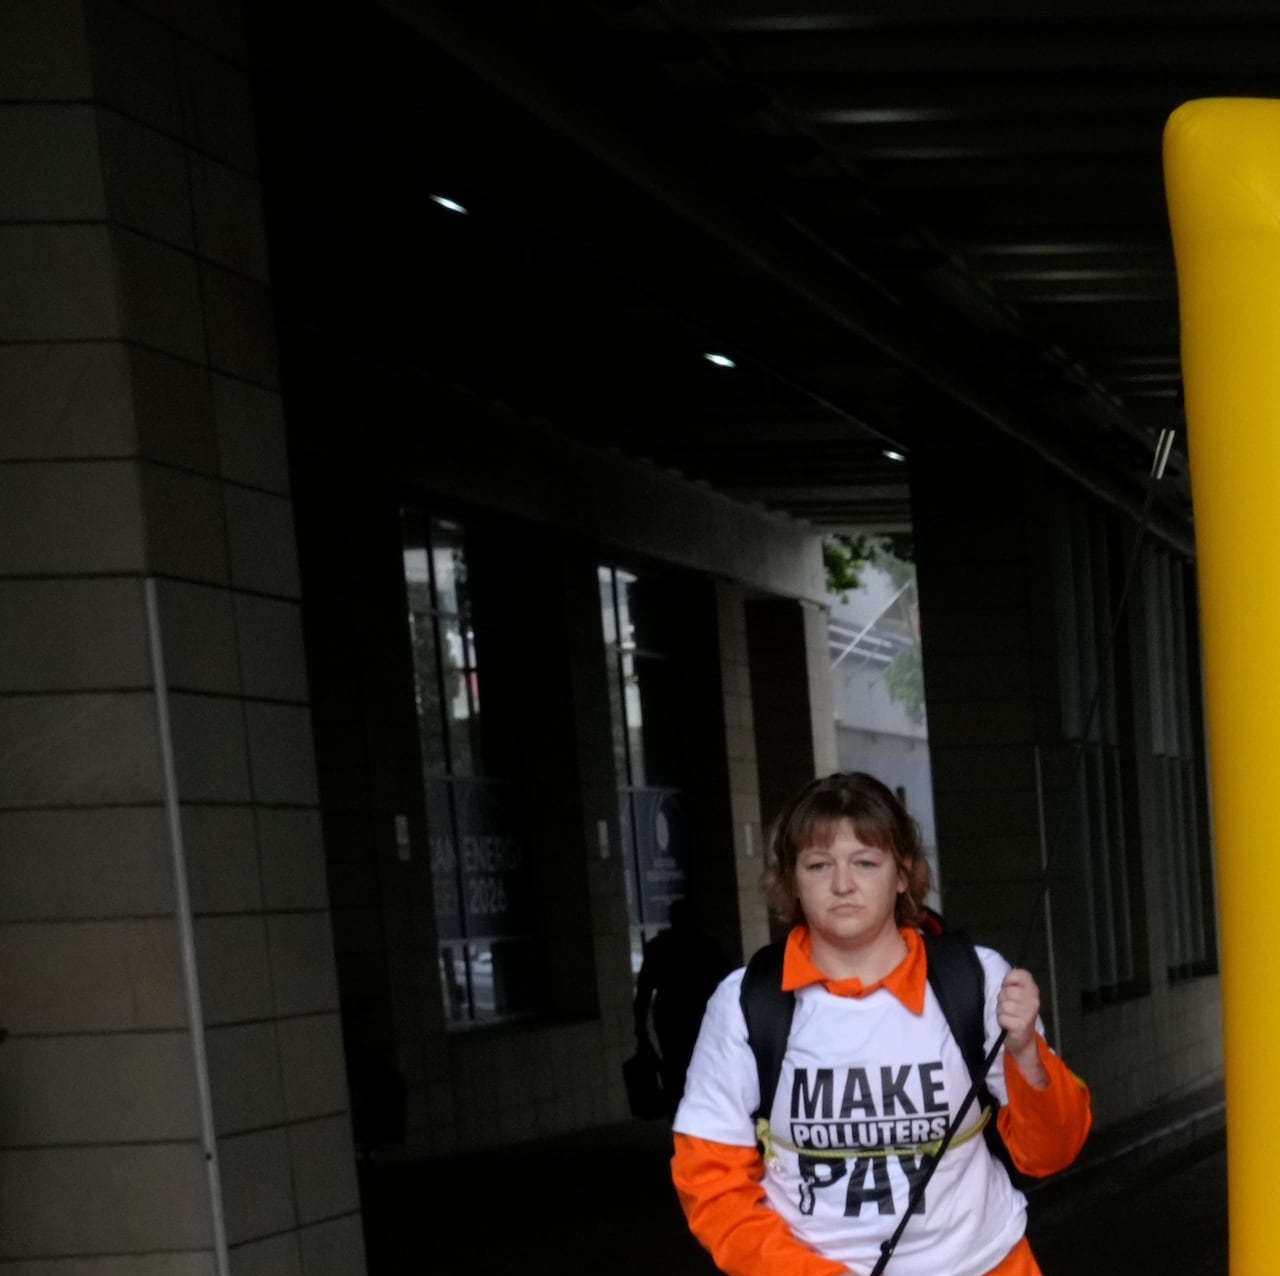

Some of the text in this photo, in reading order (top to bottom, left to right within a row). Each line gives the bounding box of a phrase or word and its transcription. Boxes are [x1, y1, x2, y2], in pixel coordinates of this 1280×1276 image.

[790, 1061, 950, 1119] MAKE
[793, 1117, 946, 1149] POLLUTERS
[798, 1147, 936, 1217] PAY
